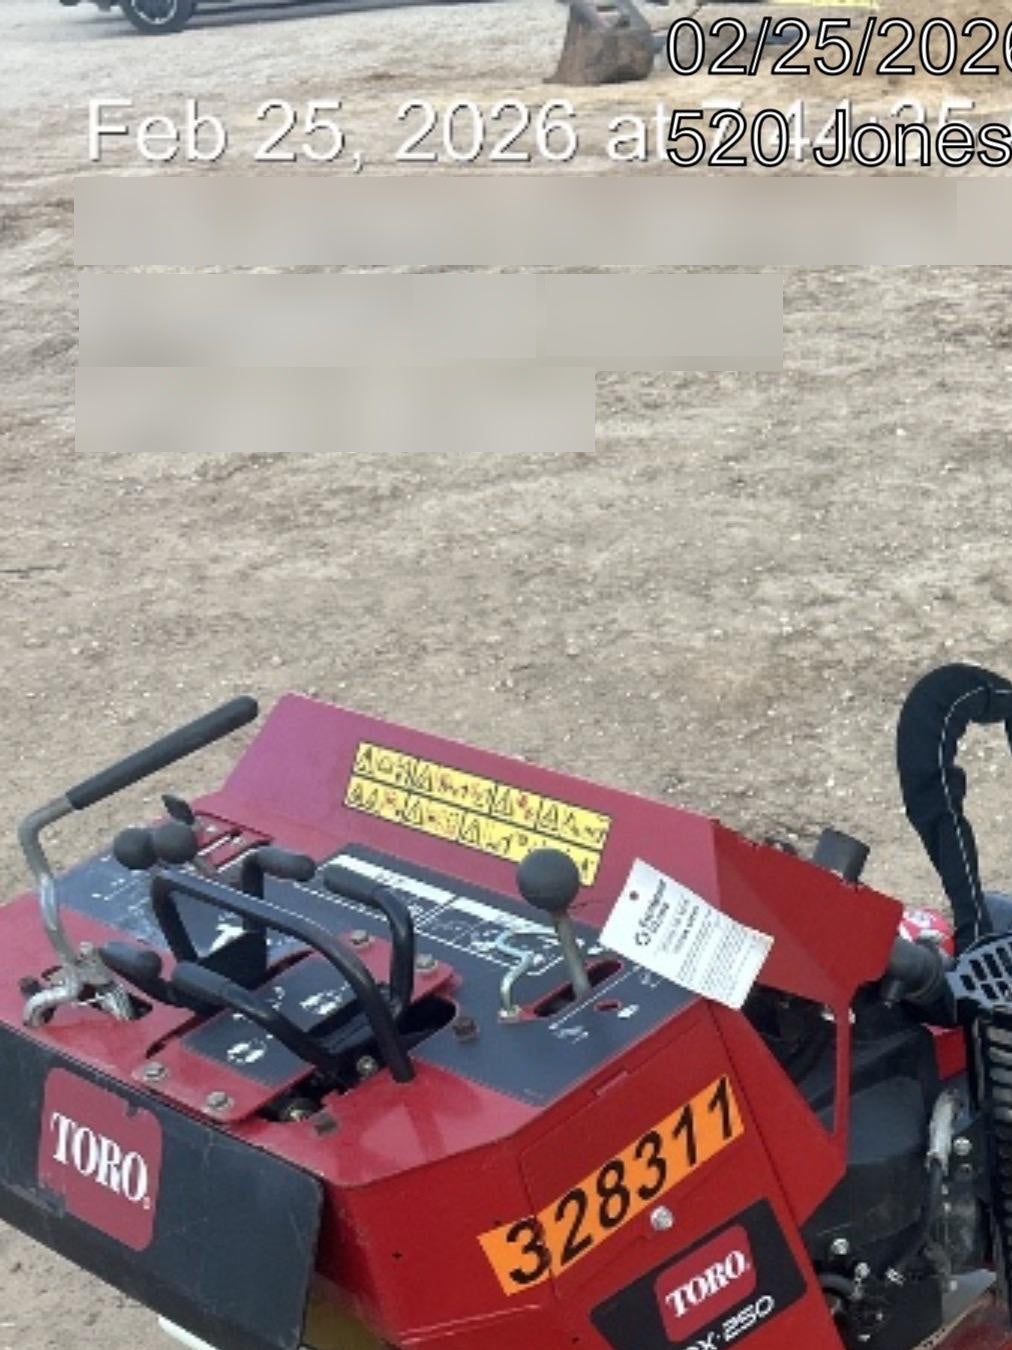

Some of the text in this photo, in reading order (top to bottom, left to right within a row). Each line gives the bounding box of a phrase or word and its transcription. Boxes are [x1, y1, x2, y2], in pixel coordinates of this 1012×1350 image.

[50, 1112, 149, 1202] TORO
[505, 1076, 732, 1285] 328311
[665, 1250, 746, 1318] TORO
